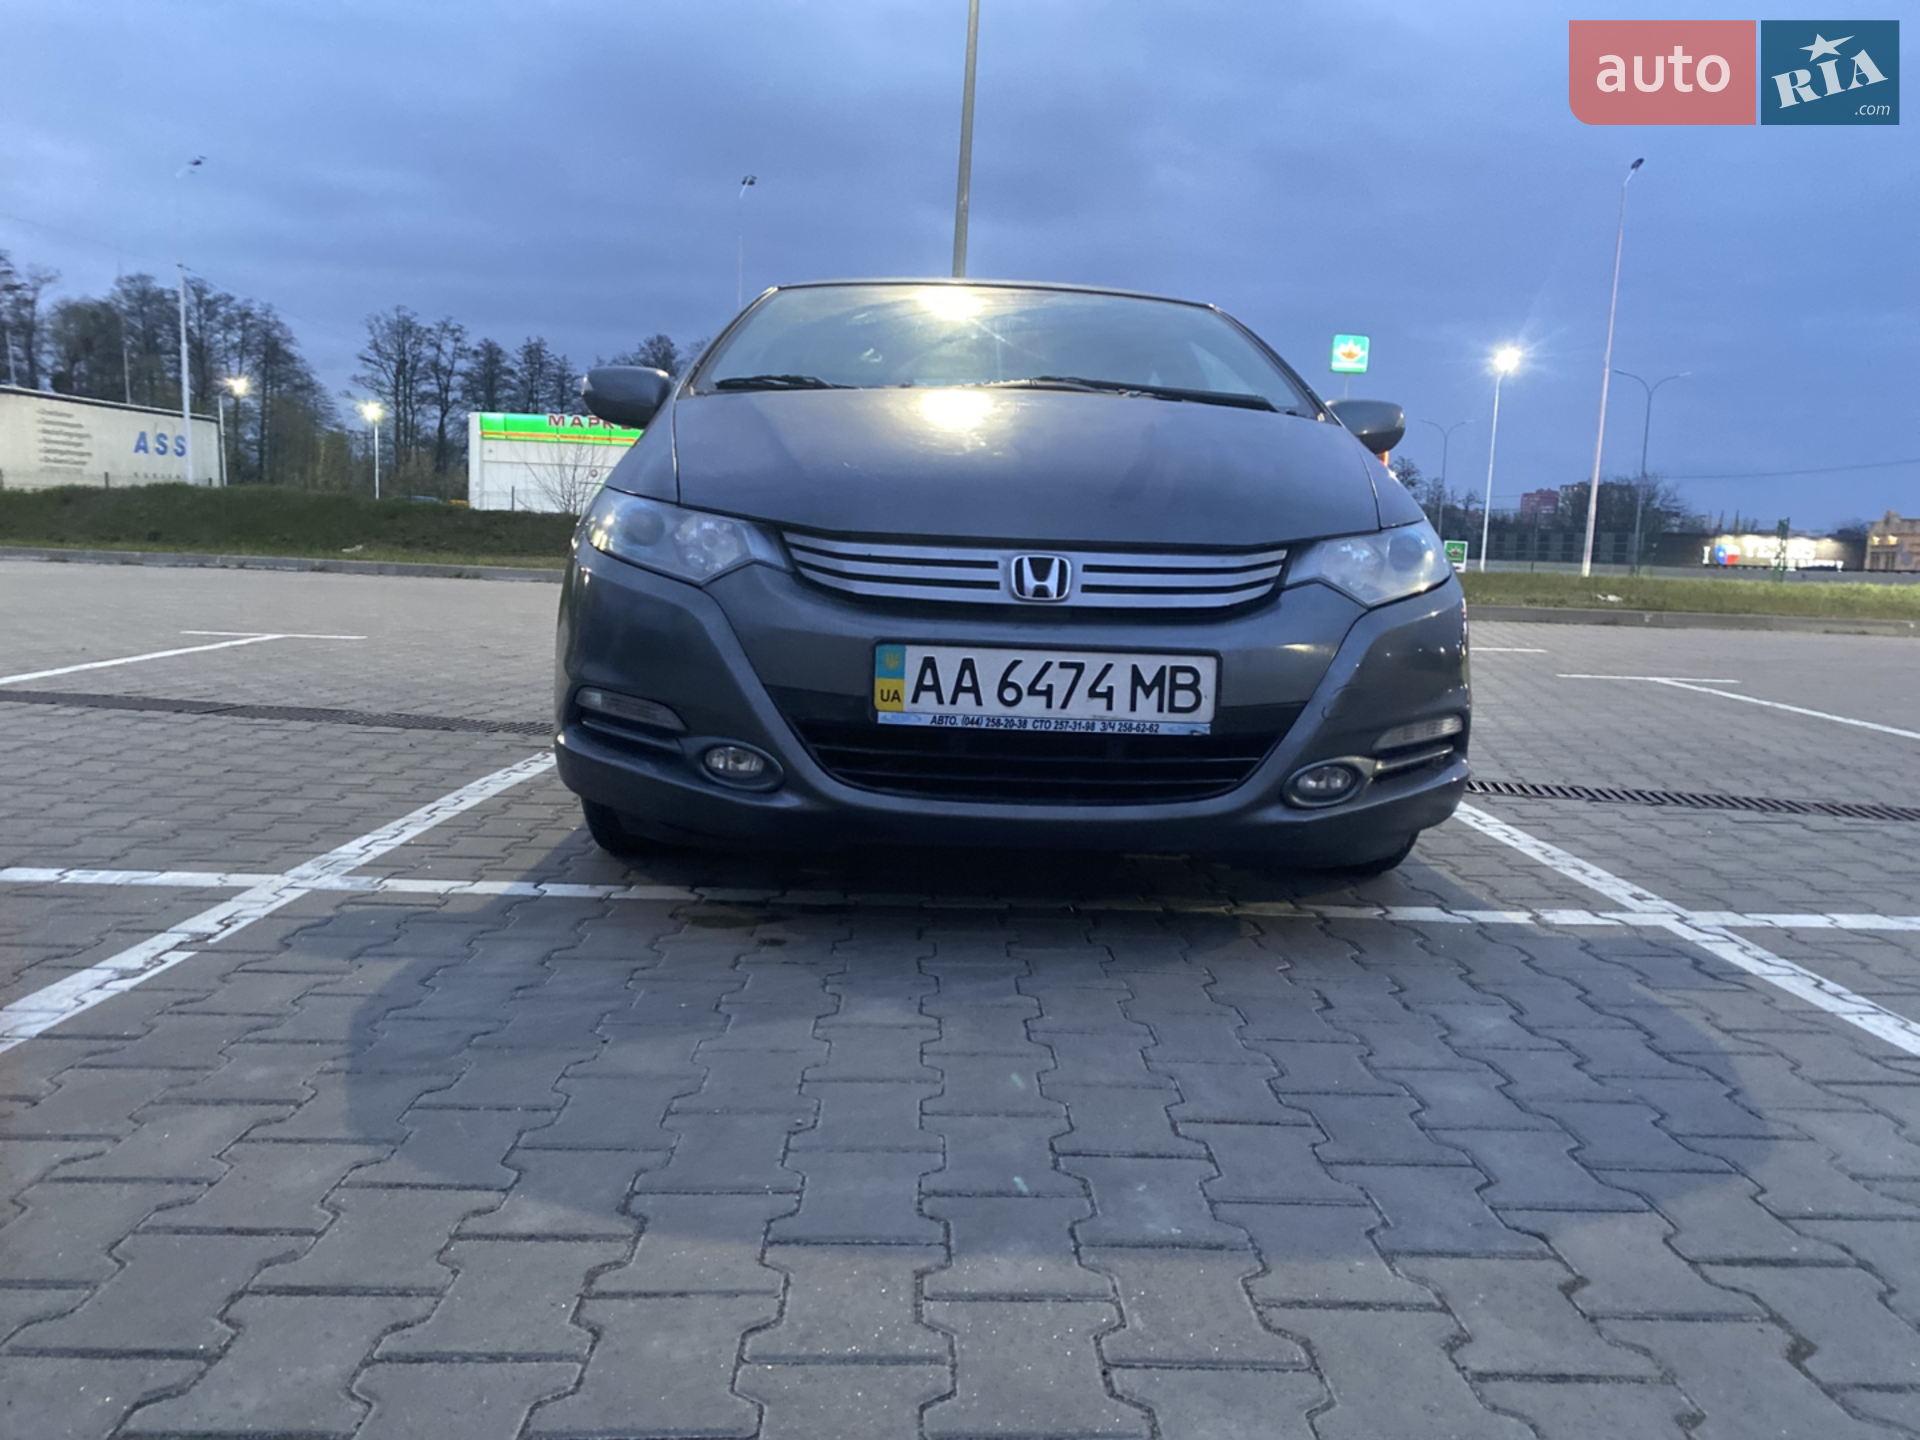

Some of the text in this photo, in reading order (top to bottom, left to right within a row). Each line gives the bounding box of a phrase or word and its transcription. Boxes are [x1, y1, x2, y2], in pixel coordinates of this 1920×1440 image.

[133, 431, 186, 457] ASS
[879, 689, 902, 703] UA
[996, 659, 1115, 711] 6474
[930, 715, 958, 726] АВТО.
[961, 715, 983, 727] (044)
[985, 717, 1028, 729] 258-20-38
[1032, 718, 1051, 730] СТО
[1053, 719, 1095, 731] 257-31-98
[1117, 721, 1160, 733] 258-62-62
